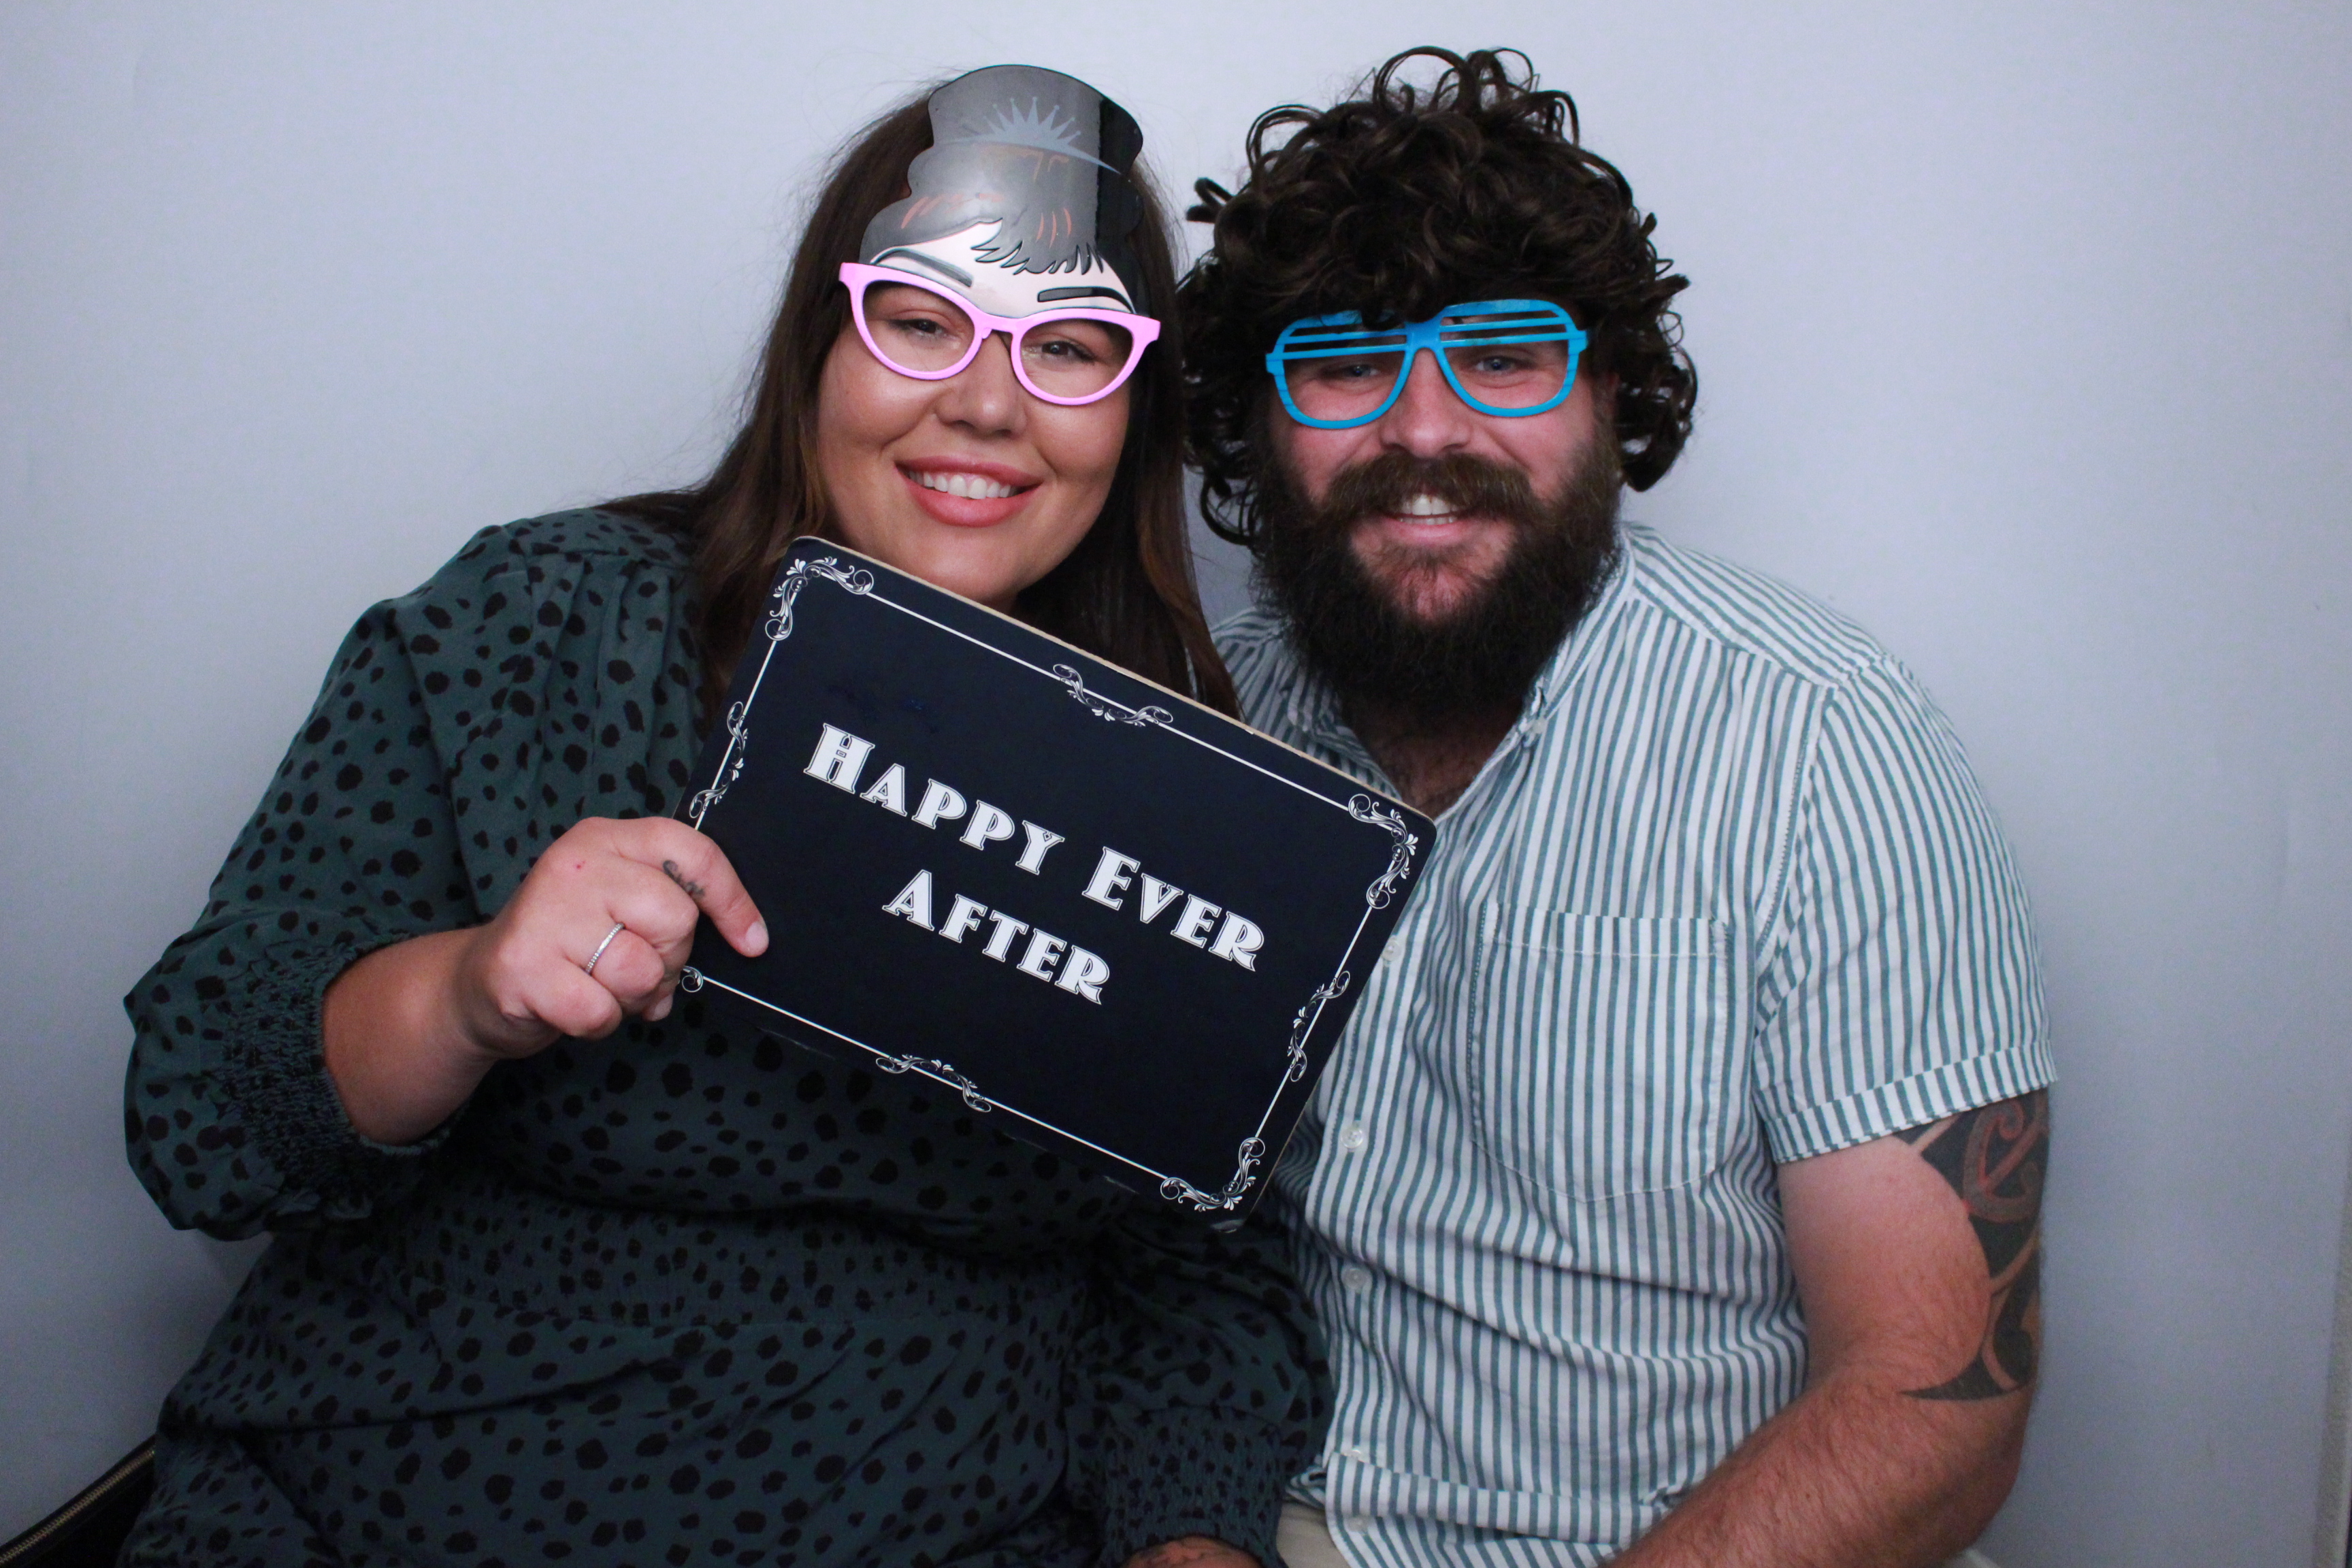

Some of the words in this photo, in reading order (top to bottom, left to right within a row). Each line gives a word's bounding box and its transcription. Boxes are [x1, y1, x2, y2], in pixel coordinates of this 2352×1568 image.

[803, 722, 1066, 875] HAPPY
[1081, 846, 1264, 972] EVER
[882, 869, 1110, 1004] AFTER
